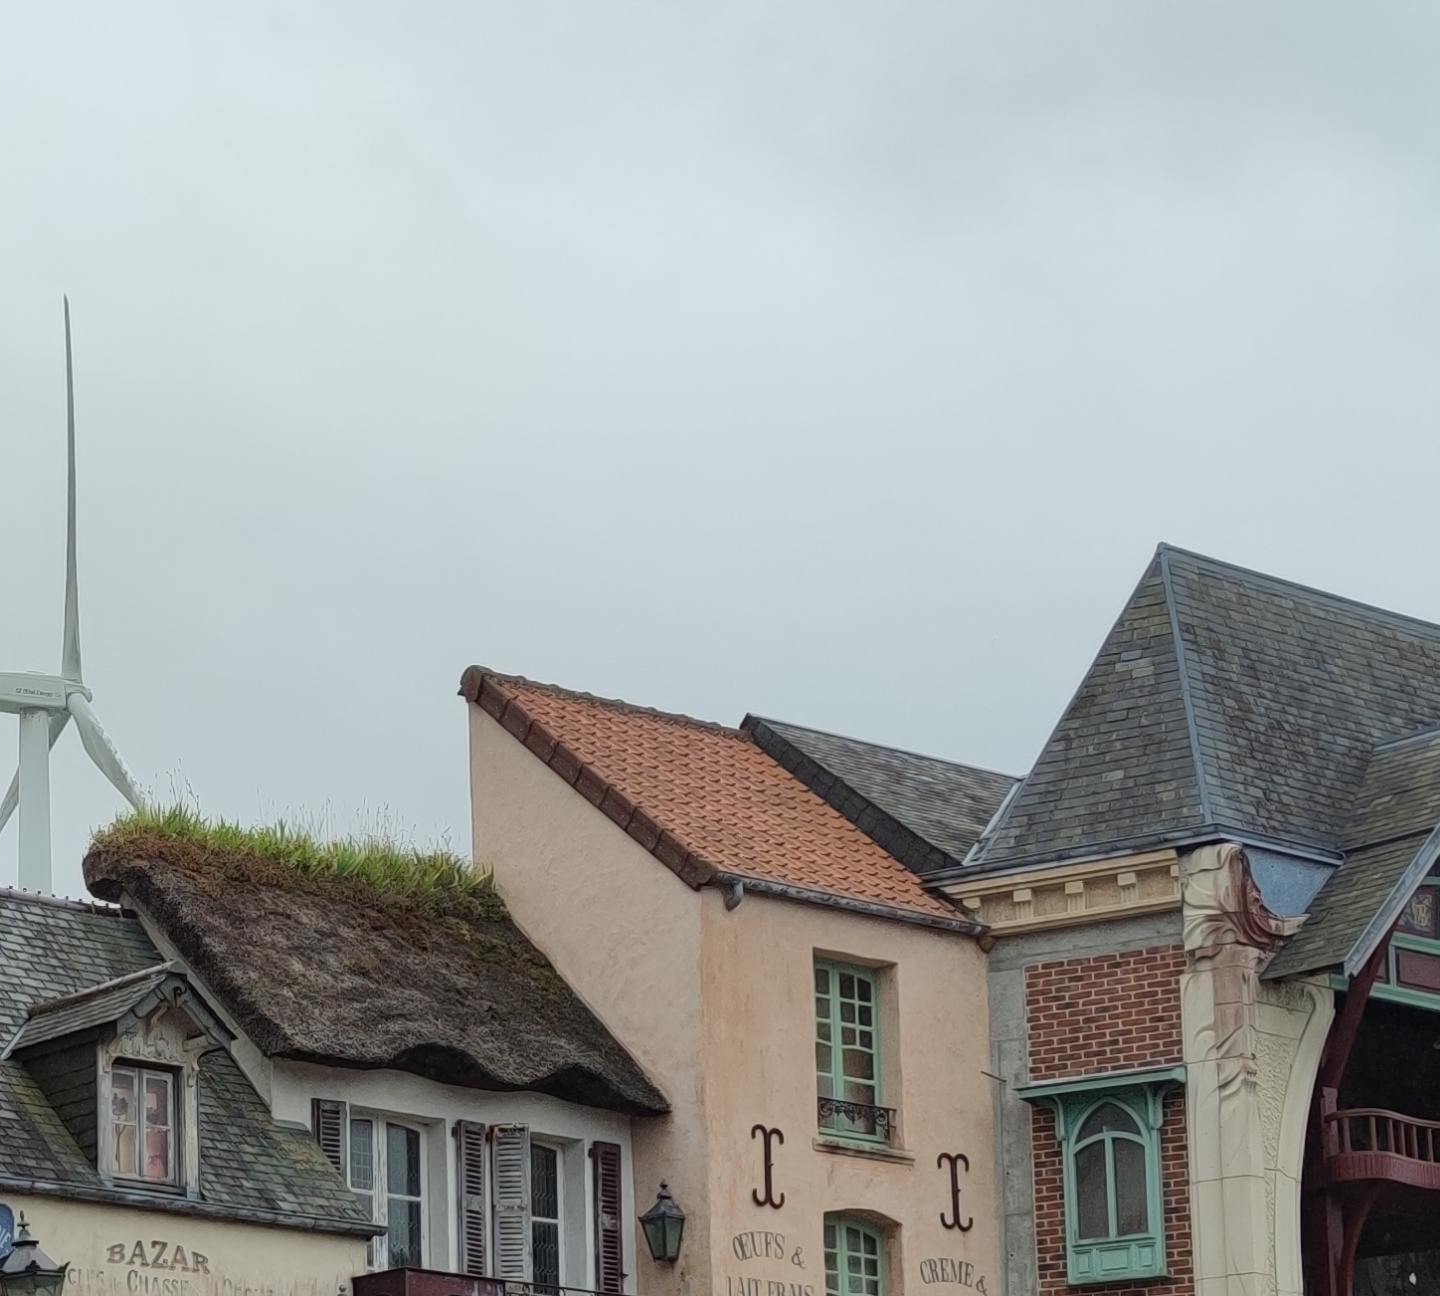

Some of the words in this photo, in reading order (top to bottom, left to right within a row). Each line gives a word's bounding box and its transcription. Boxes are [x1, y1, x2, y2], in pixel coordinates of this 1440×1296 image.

[106, 1239, 211, 1275] BAZAR
[791, 1246, 805, 1269] &
[920, 1257, 975, 1288] CREME
[976, 1275, 988, 1296] &
